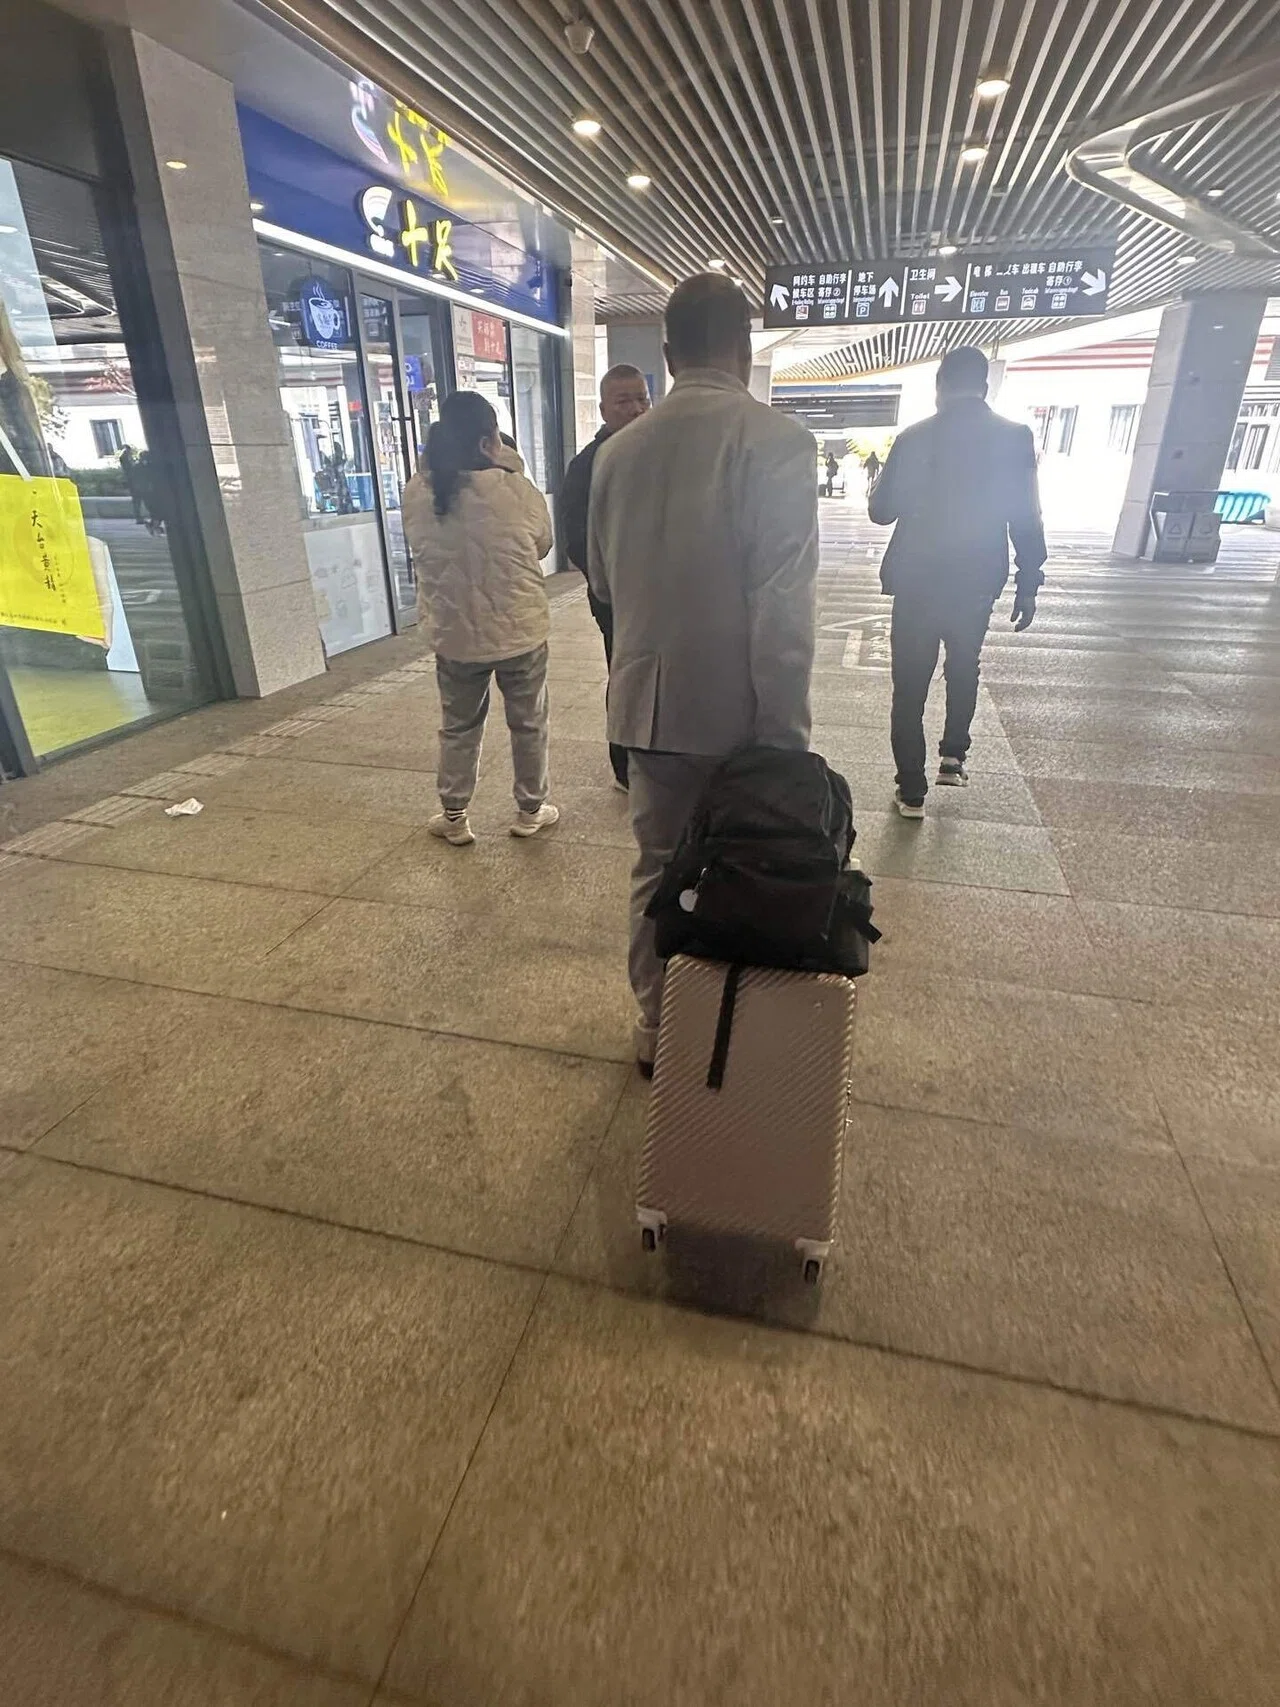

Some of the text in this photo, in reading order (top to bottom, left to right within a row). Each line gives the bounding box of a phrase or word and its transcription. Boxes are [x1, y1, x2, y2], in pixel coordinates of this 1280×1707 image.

[402, 199, 458, 280] 十足
[973, 265, 993, 278] 电梯
[1022, 262, 1046, 275] 出租车
[1048, 260, 1083, 274] 自助行李
[819, 273, 847, 285] 自助行李
[858, 271, 874, 283] 地下
[909, 268, 936, 281] 卫生间
[315, 340, 338, 350] COFFEE
